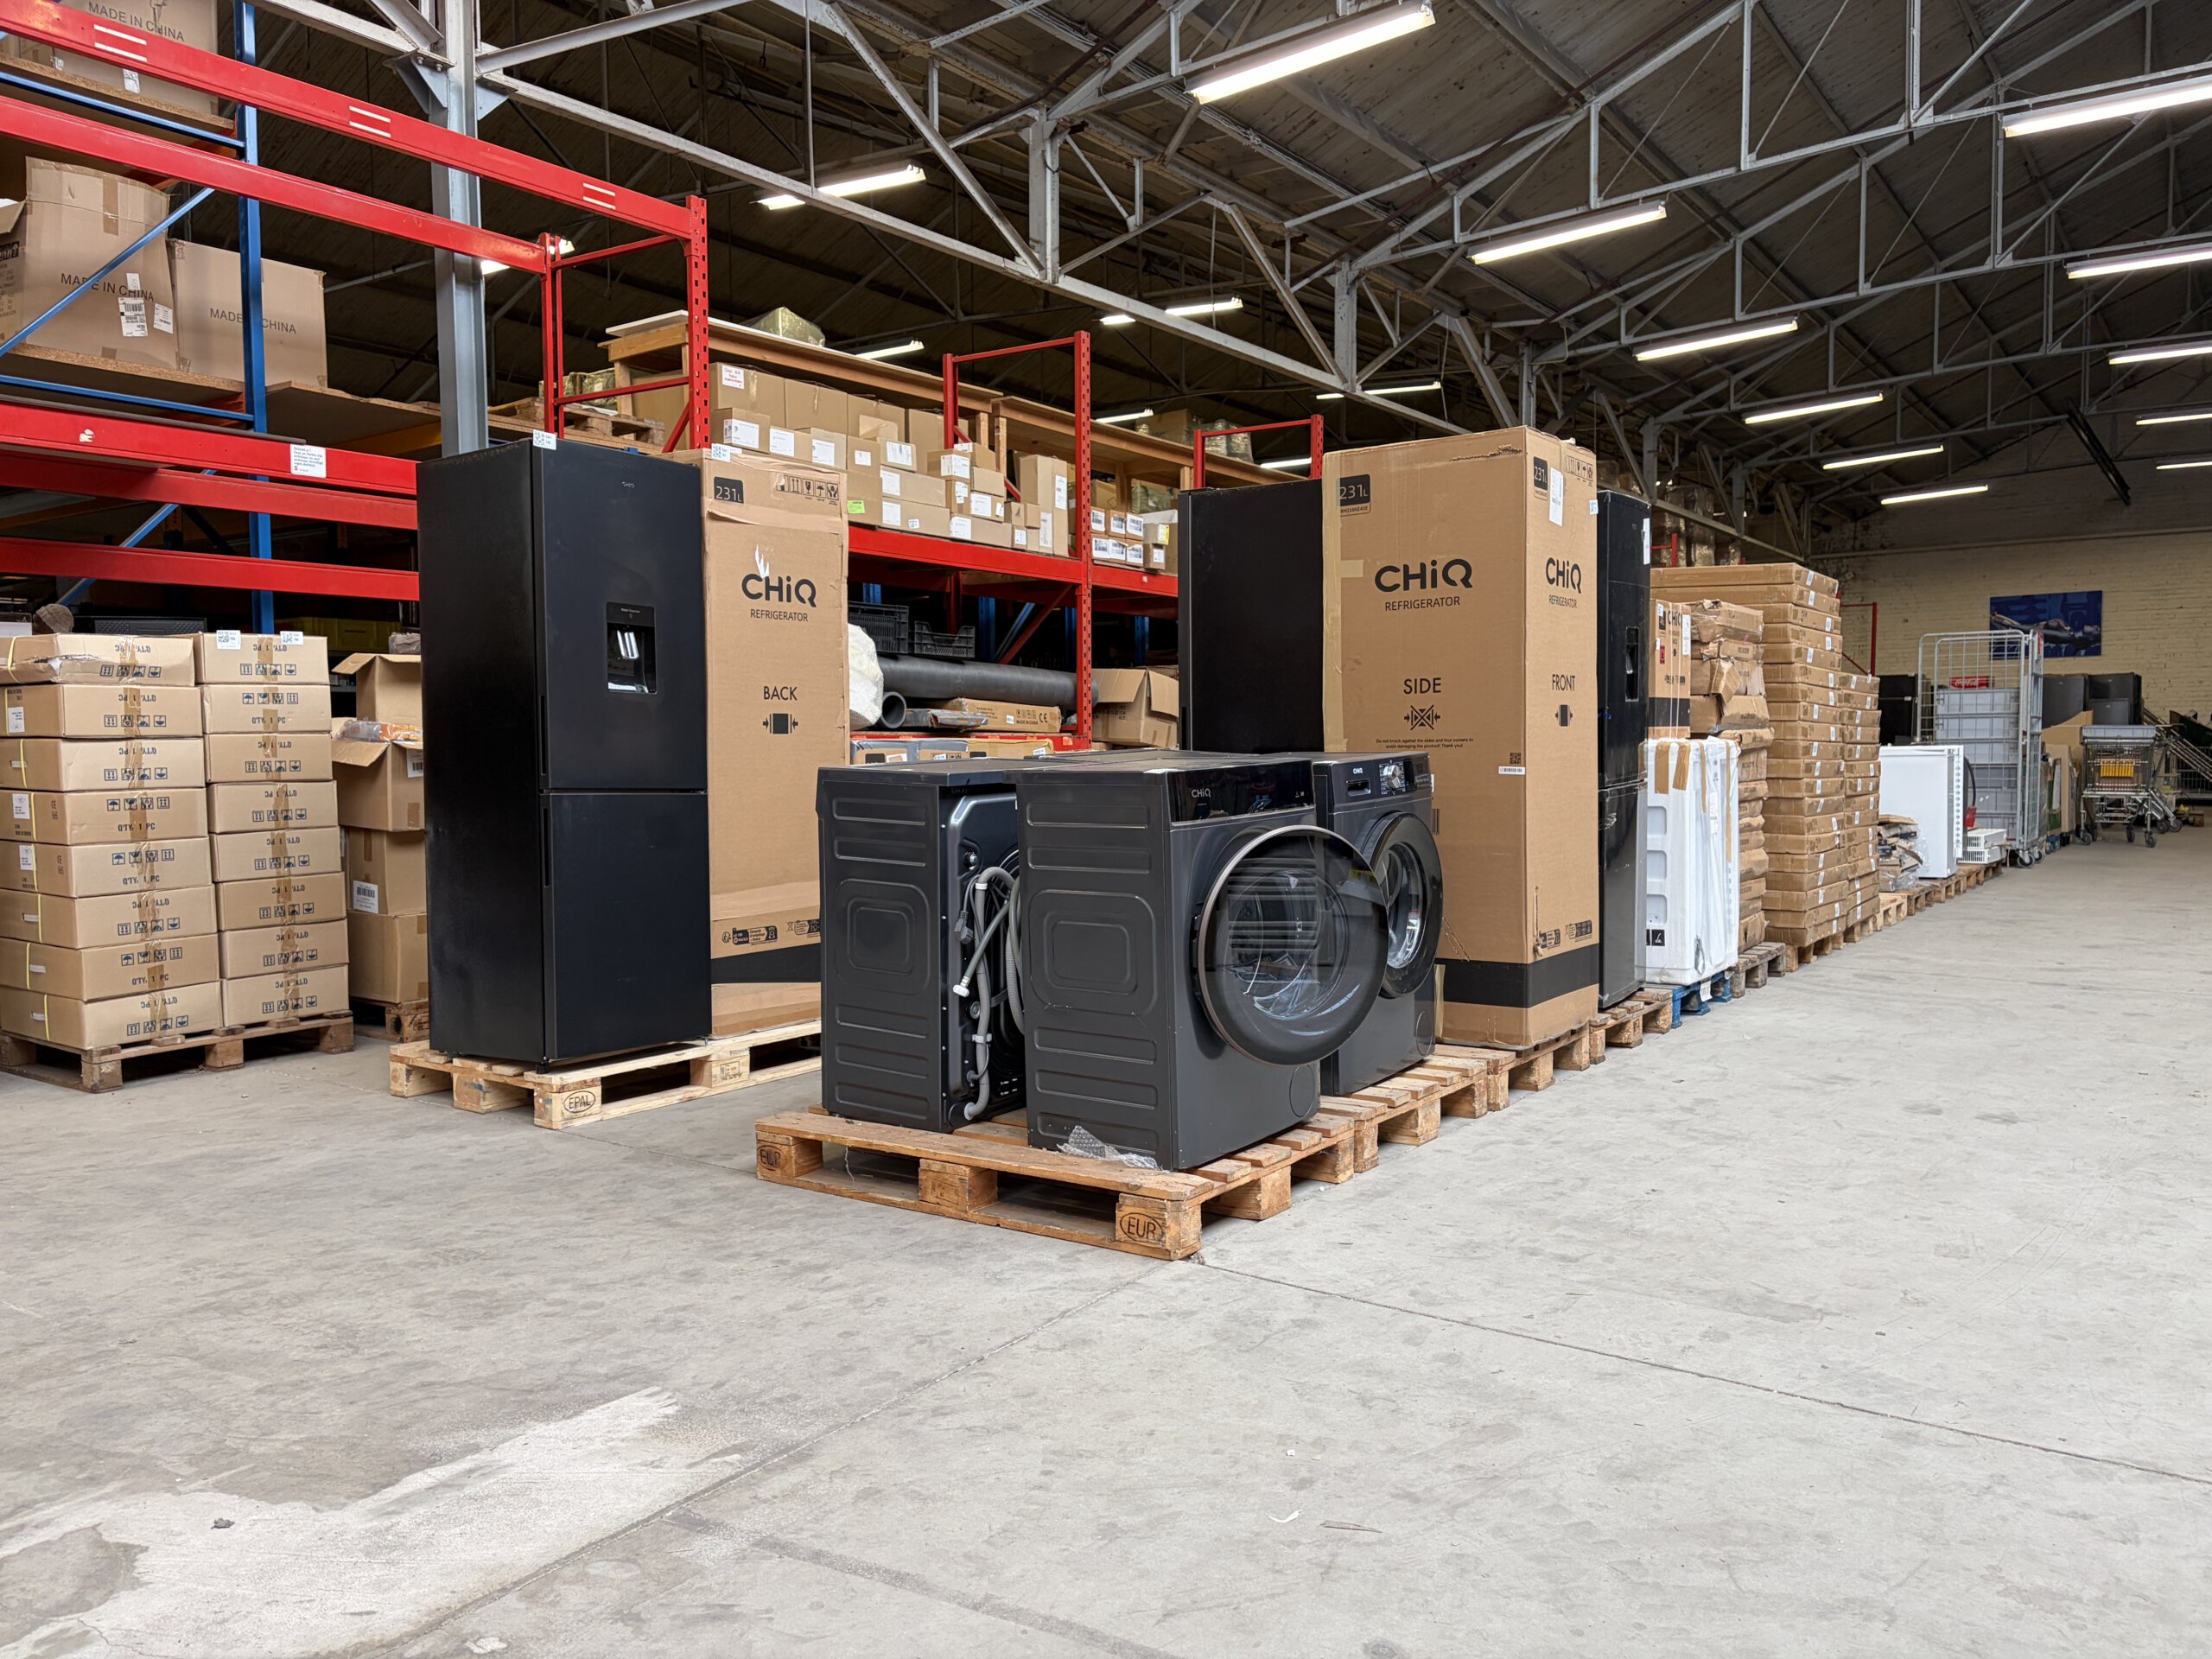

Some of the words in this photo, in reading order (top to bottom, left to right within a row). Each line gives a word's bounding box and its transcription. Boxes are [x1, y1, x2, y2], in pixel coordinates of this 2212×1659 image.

[88, 2, 127, 23] MADE
[130, 15, 143, 28] IN
[146, 21, 184, 41] CHINA
[104, 282, 116, 294] IN
[119, 285, 154, 302] CHINA
[210, 308, 243, 323] MADE
[262, 318, 296, 334] CHINA
[1375, 558, 1472, 592] CHiQ
[1546, 557, 1581, 594] CHiQ
[742, 574, 817, 607] CHiQ
[1385, 596, 1460, 611] REFRIGERATOR
[1549, 594, 1577, 608] REFRIGERATOR
[750, 608, 809, 622] REFRIGERATOR
[1403, 677, 1441, 695] SIDE
[1552, 674, 1575, 691] FRONT
[763, 685, 798, 701] BACK
[569, 1095, 591, 1109] EPAL
[1128, 1217, 1156, 1239] EUR
